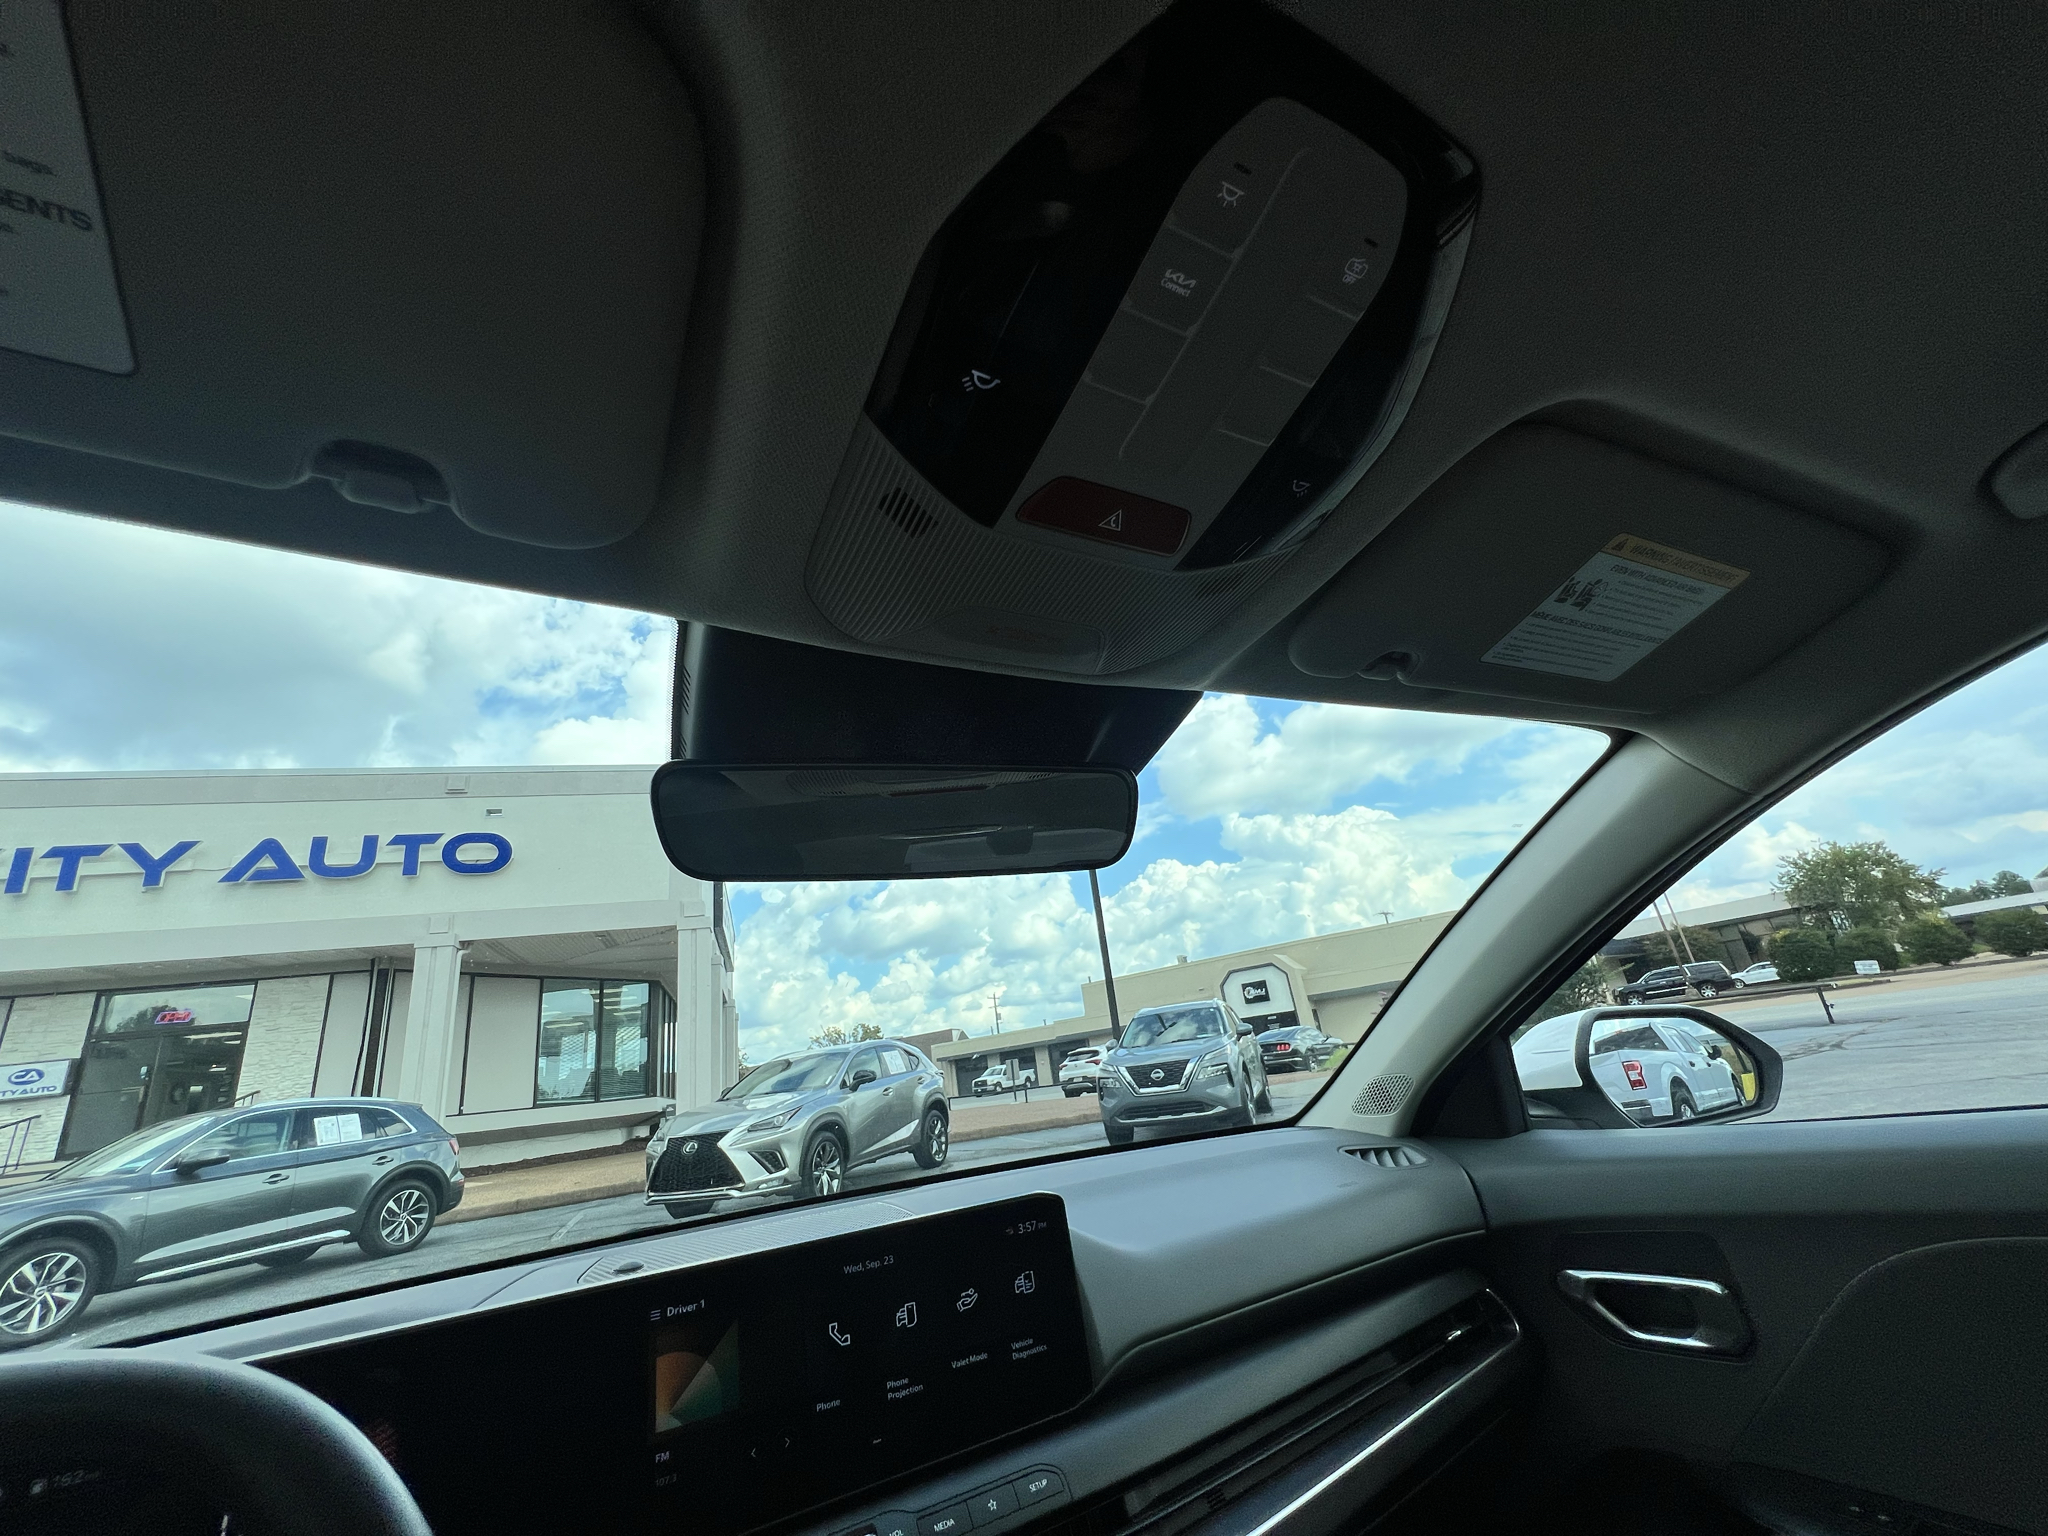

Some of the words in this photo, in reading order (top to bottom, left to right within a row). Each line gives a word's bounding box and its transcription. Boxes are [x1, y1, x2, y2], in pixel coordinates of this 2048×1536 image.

[1160, 277, 1191, 297] Connect
[1342, 274, 1357, 286] OFF
[1630, 544, 1673, 563] WARNING
[0, 840, 203, 895] ITY
[217, 832, 514, 883] AUTO
[11, 1070, 40, 1082] CA
[0, 1089, 20, 1097] TY
[19, 1085, 57, 1095] AUTO
[1018, 1220, 1037, 1234] 3:57
[843, 1262, 865, 1275] Wed,
[866, 1260, 881, 1272] Sep.
[883, 1255, 894, 1265] 23
[667, 1303, 698, 1317] Driver
[700, 1298, 705, 1309] 1
[1011, 1338, 1034, 1350] Vehicle
[1012, 1344, 1048, 1360] Diagnostics
[951, 1358, 970, 1369] Valet
[969, 1352, 988, 1363] Mode
[887, 1378, 909, 1390] Phone
[888, 1384, 924, 1401] Projection
[816, 1399, 841, 1412] Phone
[655, 1450, 670, 1464] FM
[1028, 1478, 1048, 1492] SETUP
[933, 1518, 956, 1532] MEDIA
